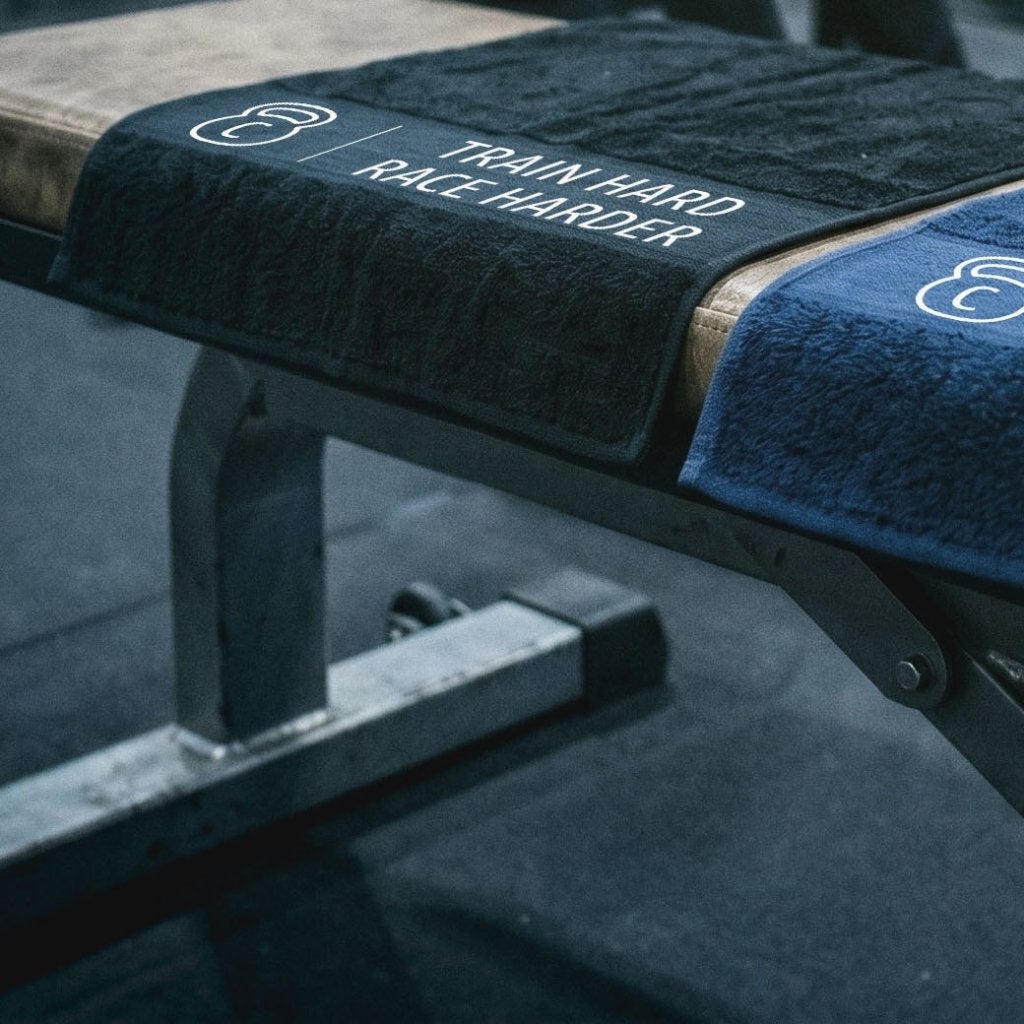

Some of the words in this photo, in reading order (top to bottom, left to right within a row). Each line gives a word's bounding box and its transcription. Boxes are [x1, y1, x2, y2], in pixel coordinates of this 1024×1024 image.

[351, 159, 499, 199] RACE
[477, 188, 703, 247] HARDER
[438, 140, 603, 185] TRAIN
[583, 173, 746, 217] HARD
